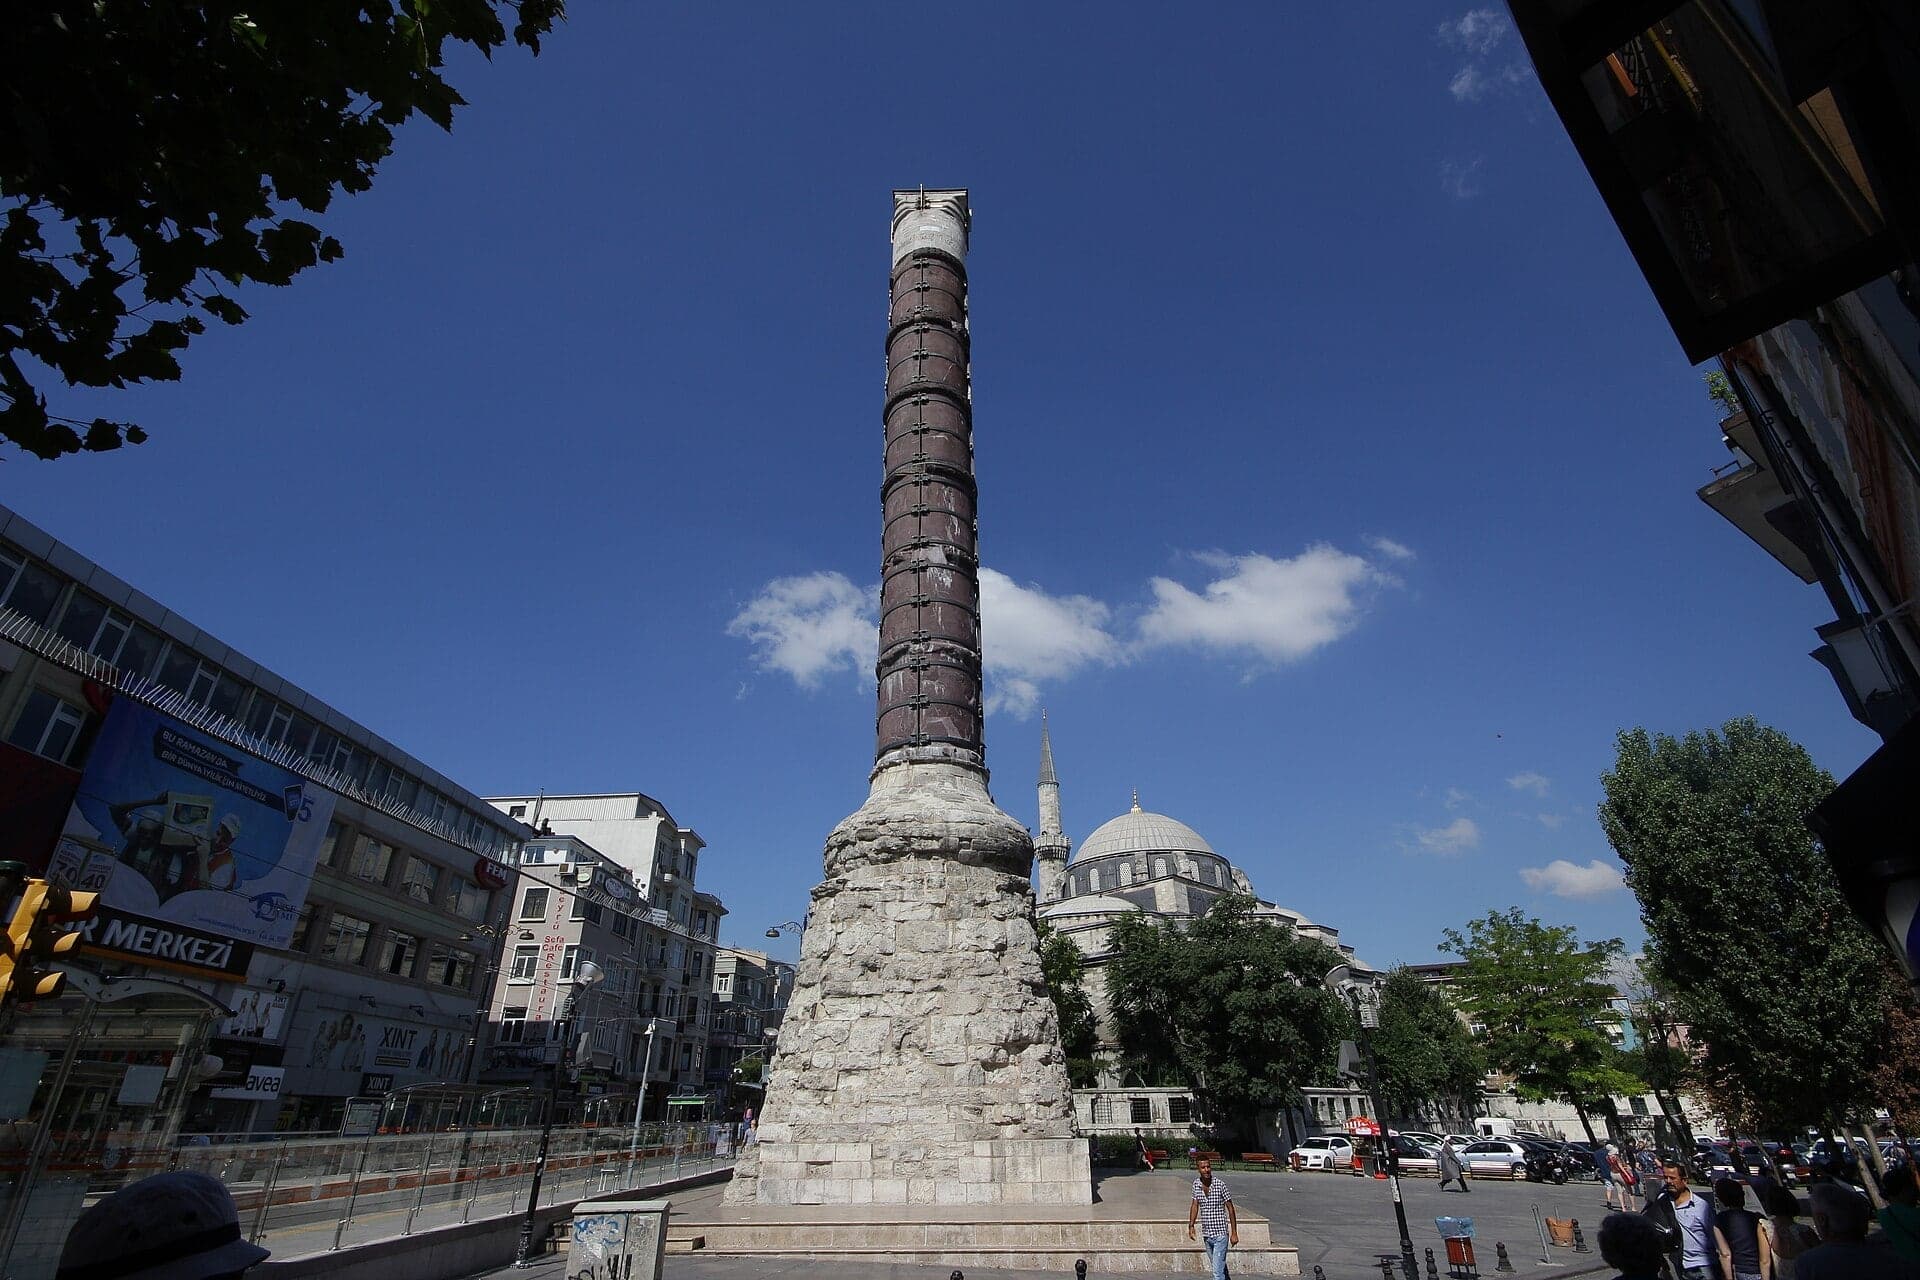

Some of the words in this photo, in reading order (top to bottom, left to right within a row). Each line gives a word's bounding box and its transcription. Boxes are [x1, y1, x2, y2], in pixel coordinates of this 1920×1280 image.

[162, 730, 177, 743] BU
[101, 918, 235, 969] MERKEZİ
[544, 935, 565, 944] Sefa
[379, 1026, 418, 1050] XINT
[245, 1075, 281, 1092] avea
[367, 1075, 391, 1090] XINT
